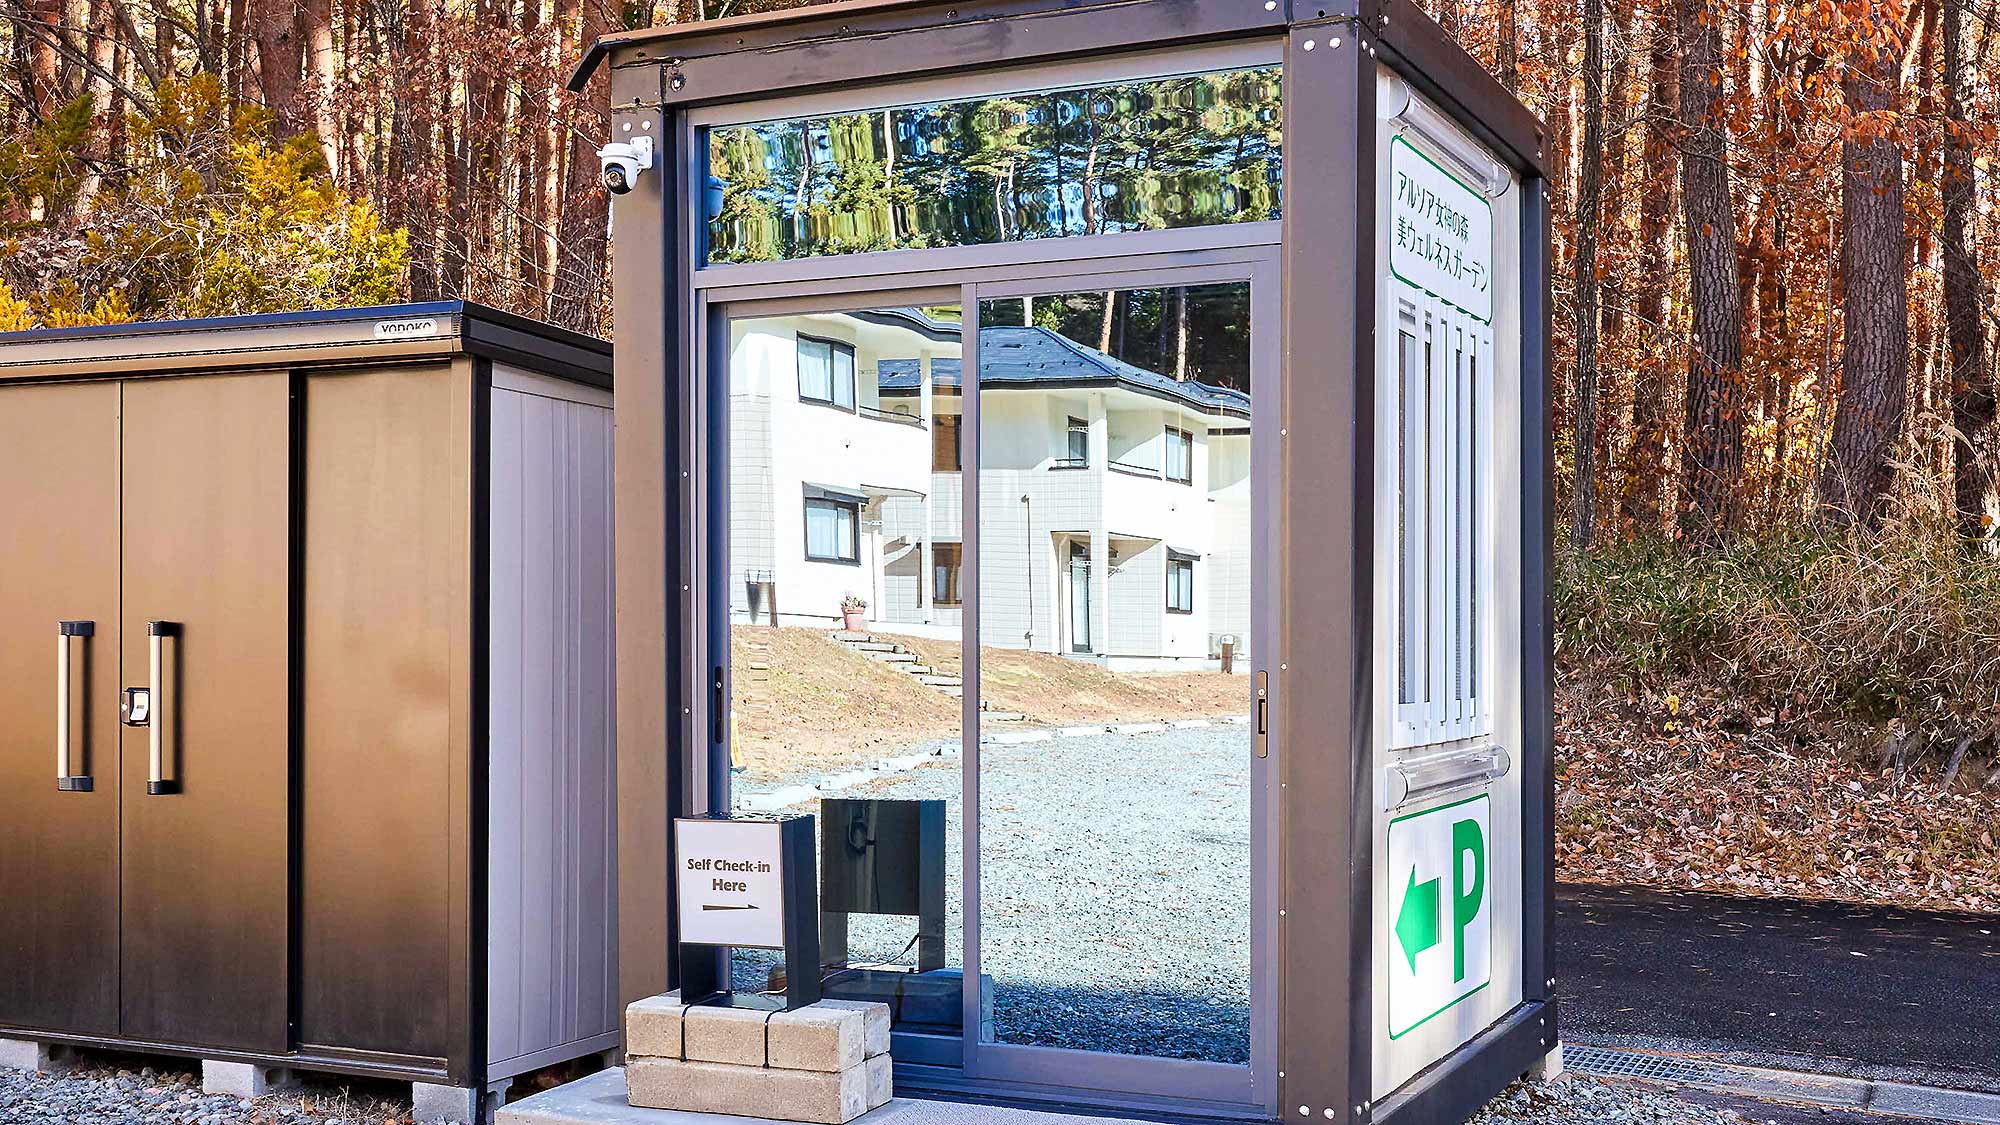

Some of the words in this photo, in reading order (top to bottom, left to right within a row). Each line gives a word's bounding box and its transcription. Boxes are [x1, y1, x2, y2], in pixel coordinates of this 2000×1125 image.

[1397, 170, 1469, 244] アルソア女神の森
[1397, 213, 1489, 293] 美ウェルネスガーデン
[687, 858, 712, 871] Self
[713, 859, 771, 873] Check-in
[712, 878, 747, 892] Here
[1452, 818, 1485, 985] P
